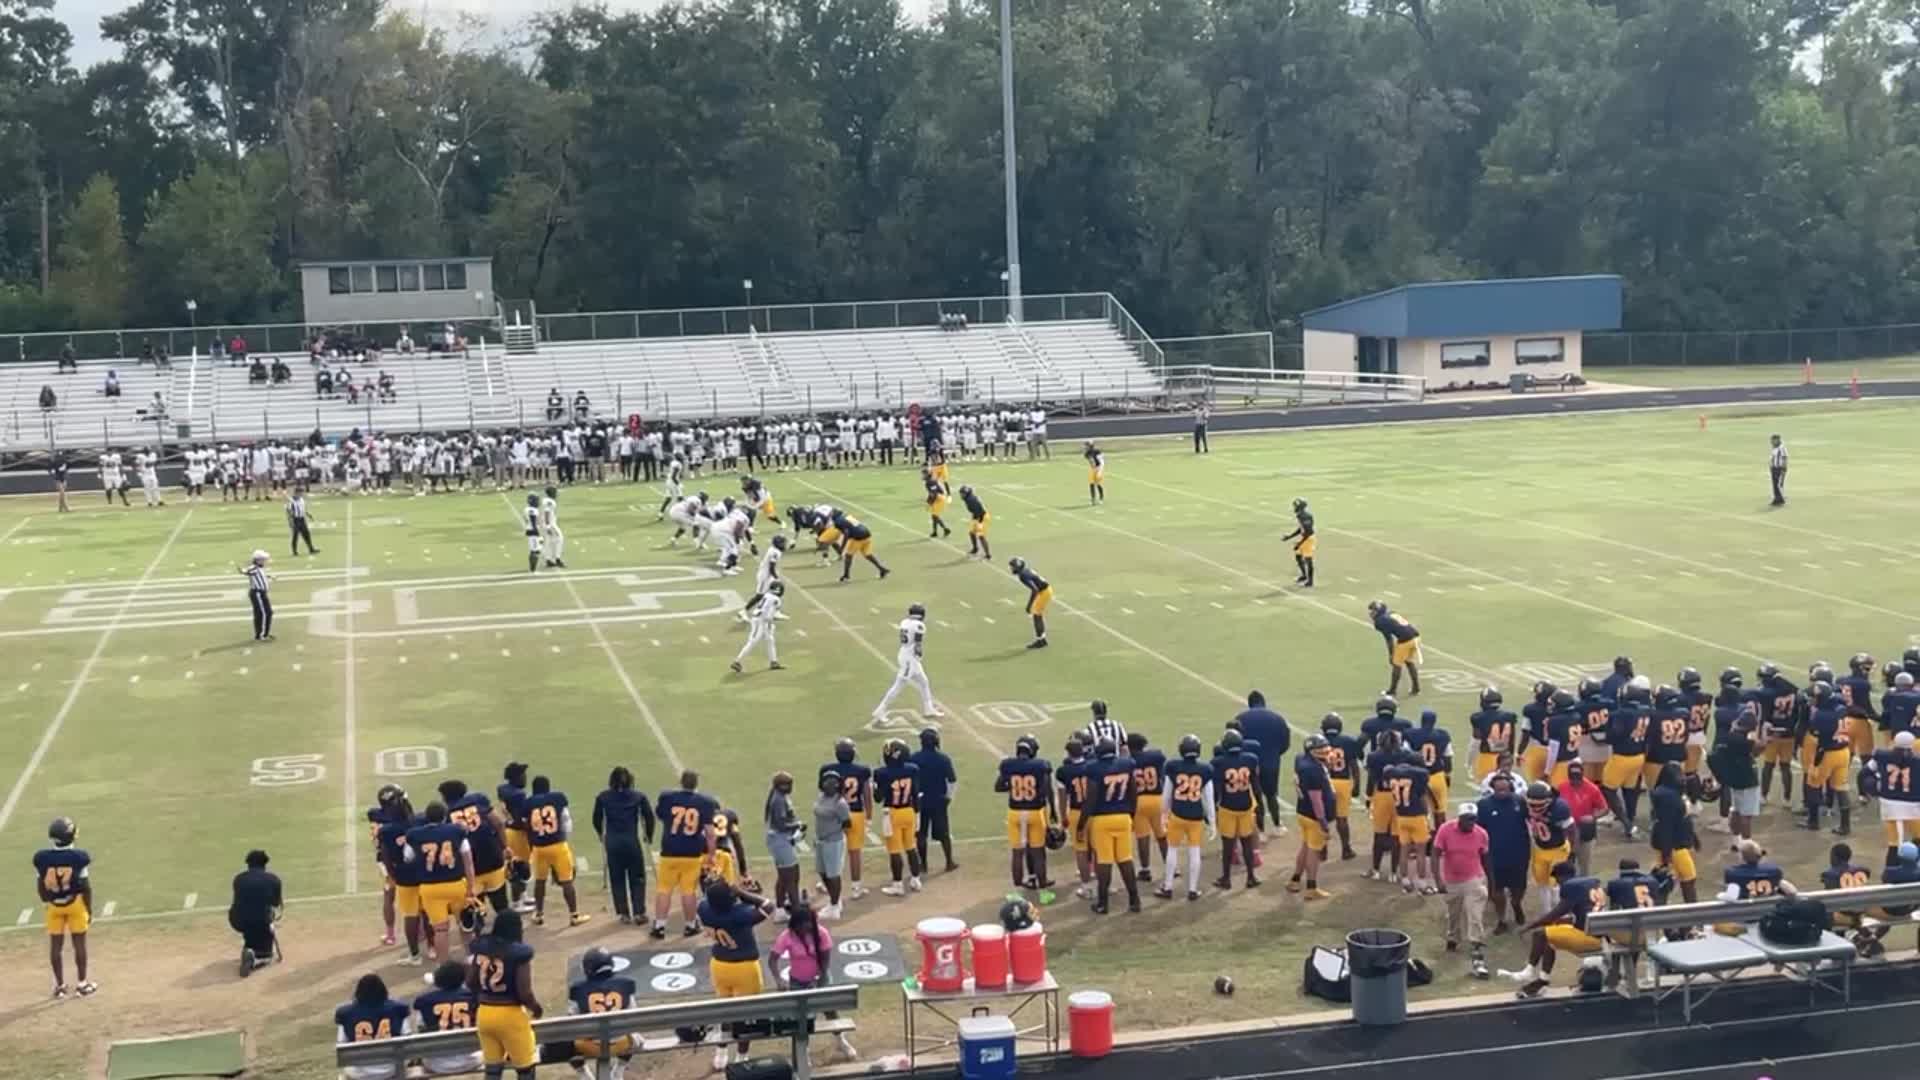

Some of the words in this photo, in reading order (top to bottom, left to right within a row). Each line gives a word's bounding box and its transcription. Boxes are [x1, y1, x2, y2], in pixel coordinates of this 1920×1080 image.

[249, 745, 449, 786] 50
[530, 805, 558, 837] 43
[670, 805, 699, 836] 79
[421, 840, 456, 872] 74
[44, 866, 72, 893] 47
[937, 944, 953, 963] G
